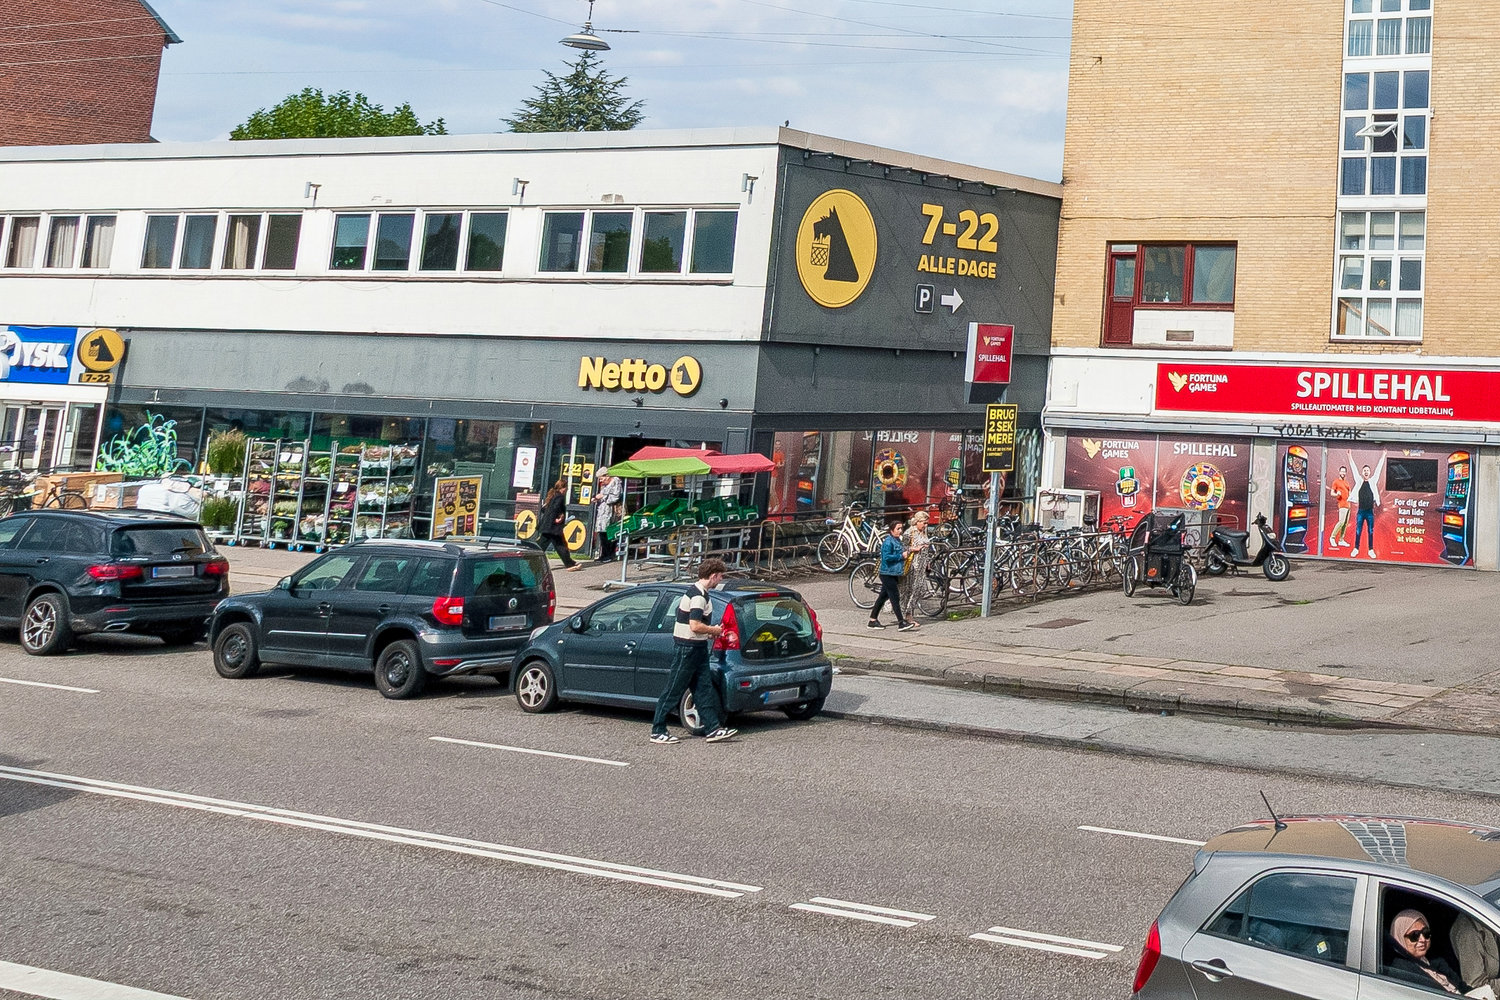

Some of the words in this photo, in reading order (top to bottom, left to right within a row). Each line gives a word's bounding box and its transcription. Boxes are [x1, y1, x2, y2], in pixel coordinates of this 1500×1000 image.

[922, 203, 999, 253] 7-22
[917, 254, 956, 275] ALLE
[957, 258, 997, 279] DAGE
[9, 332, 71, 368] JYSK
[978, 354, 1007, 363] SPILLEHAL
[86, 374, 111, 382] 7-22
[578, 356, 666, 391] Netto
[1189, 374, 1229, 383] FORTUNA
[1188, 383, 1218, 393] GAMES
[1296, 371, 1451, 402] SPILLEHAL
[990, 408, 1015, 420] BRUG
[1291, 403, 1355, 412] SPILLEAUTOMATER
[1356, 405, 1372, 413] MED
[1373, 406, 1407, 414] KONTANT
[1408, 407, 1454, 417] UDBETALING
[989, 421, 996, 432] 2
[996, 421, 1014, 432] SEK
[987, 433, 1013, 445] MERE
[1102, 440, 1140, 450] FORTUNA
[1173, 442, 1238, 457] SPILLEHAL
[1102, 449, 1129, 459] GAMES
[1406, 499, 1417, 508] dig
[1417, 499, 1430, 507] der
[1411, 508, 1424, 516] lide
[1406, 517, 1424, 526] spille
[1396, 526, 1405, 534] og
[1405, 526, 1425, 534] elsker
